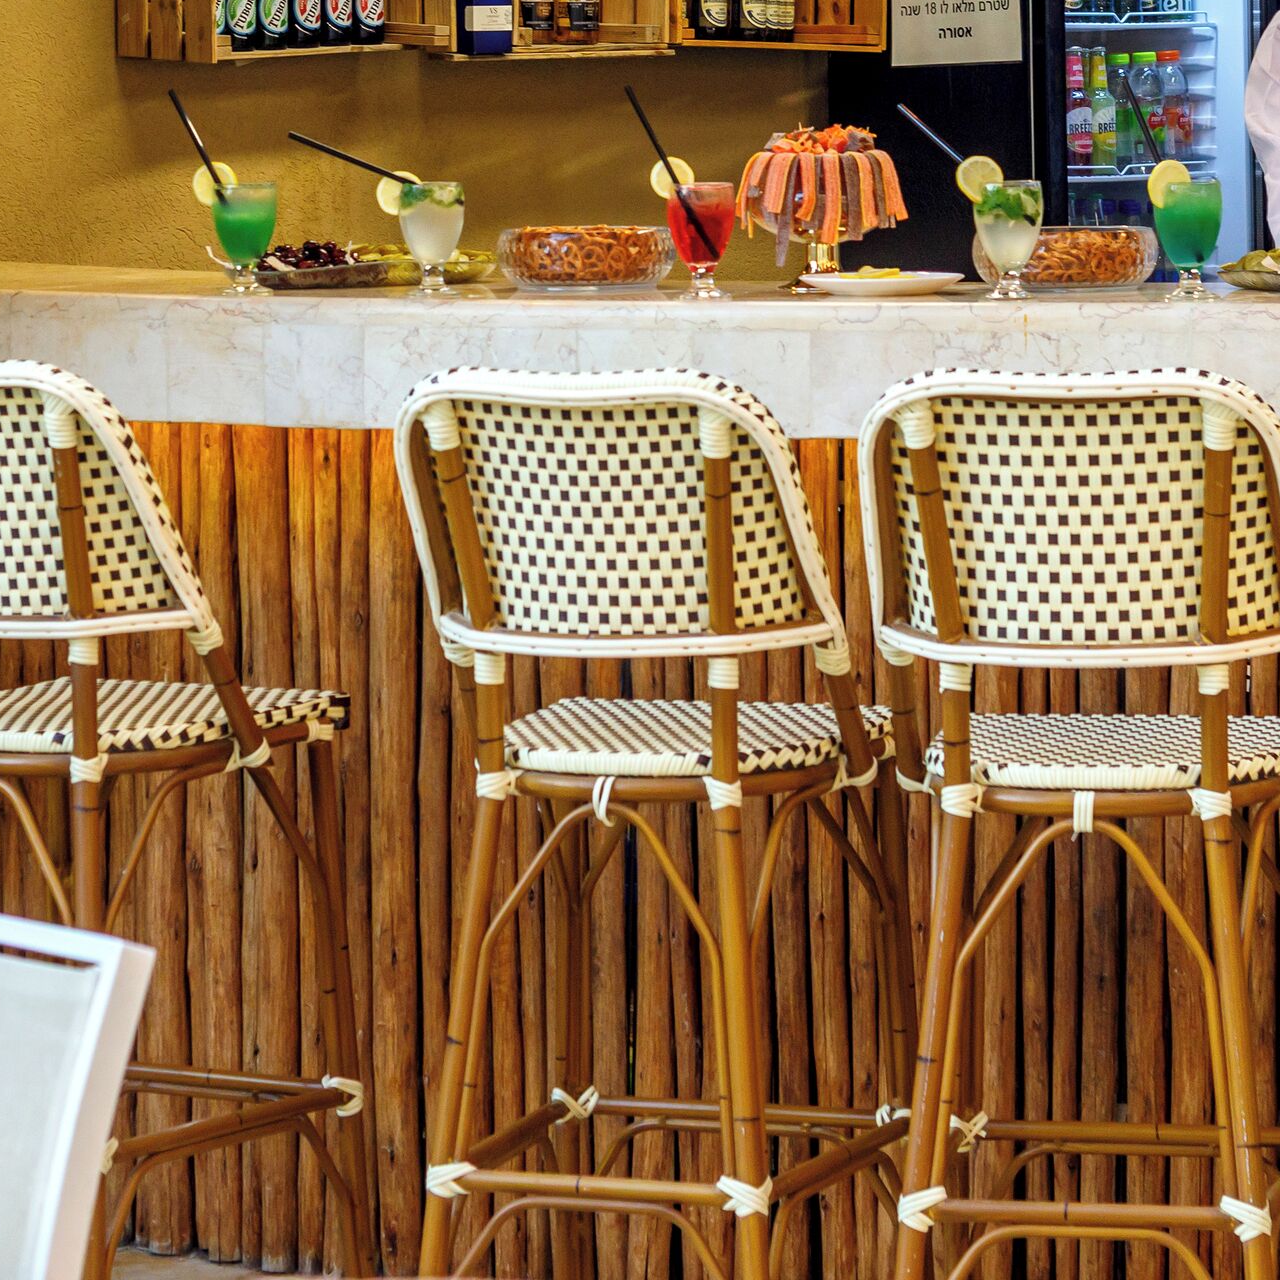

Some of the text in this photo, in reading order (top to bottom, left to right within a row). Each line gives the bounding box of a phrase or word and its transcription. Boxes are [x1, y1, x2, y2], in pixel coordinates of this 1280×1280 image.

[900, 5, 921, 17] שנה
[924, 1, 937, 15] 18
[940, 0, 949, 14] לו
[978, 0, 1010, 12] שטרם
[938, 26, 973, 39] אסורה
